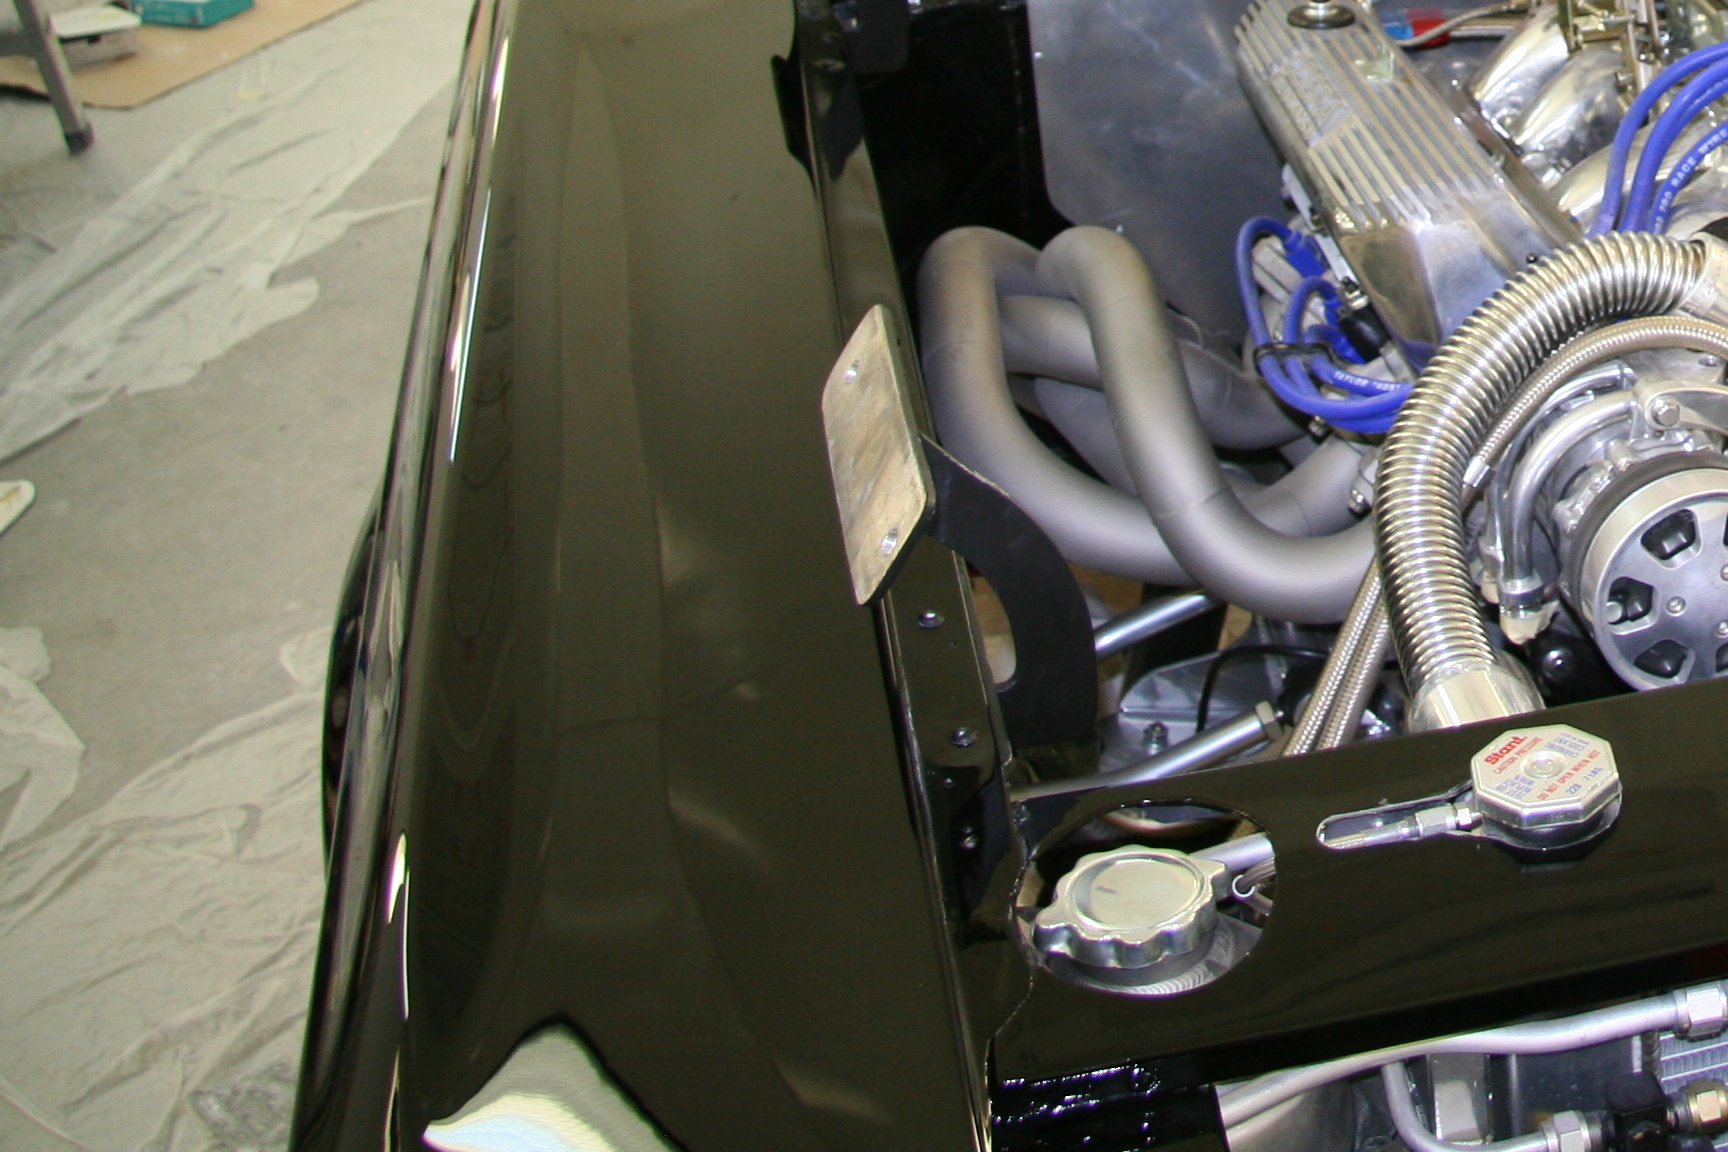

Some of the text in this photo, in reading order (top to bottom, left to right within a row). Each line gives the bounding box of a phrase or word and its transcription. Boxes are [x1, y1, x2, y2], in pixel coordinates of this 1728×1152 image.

[1671, 156, 1697, 187] RACE
[1698, 128, 1728, 154] WIRE
[1334, 371, 1369, 387] TAYLOR
[1493, 736, 1543, 774] CAUTION PRESSURE
[1545, 783, 1559, 793] NOT
[1556, 772, 1575, 784] OPEN
[1571, 759, 1591, 772] WHEN
[1587, 749, 1601, 759] HOT
